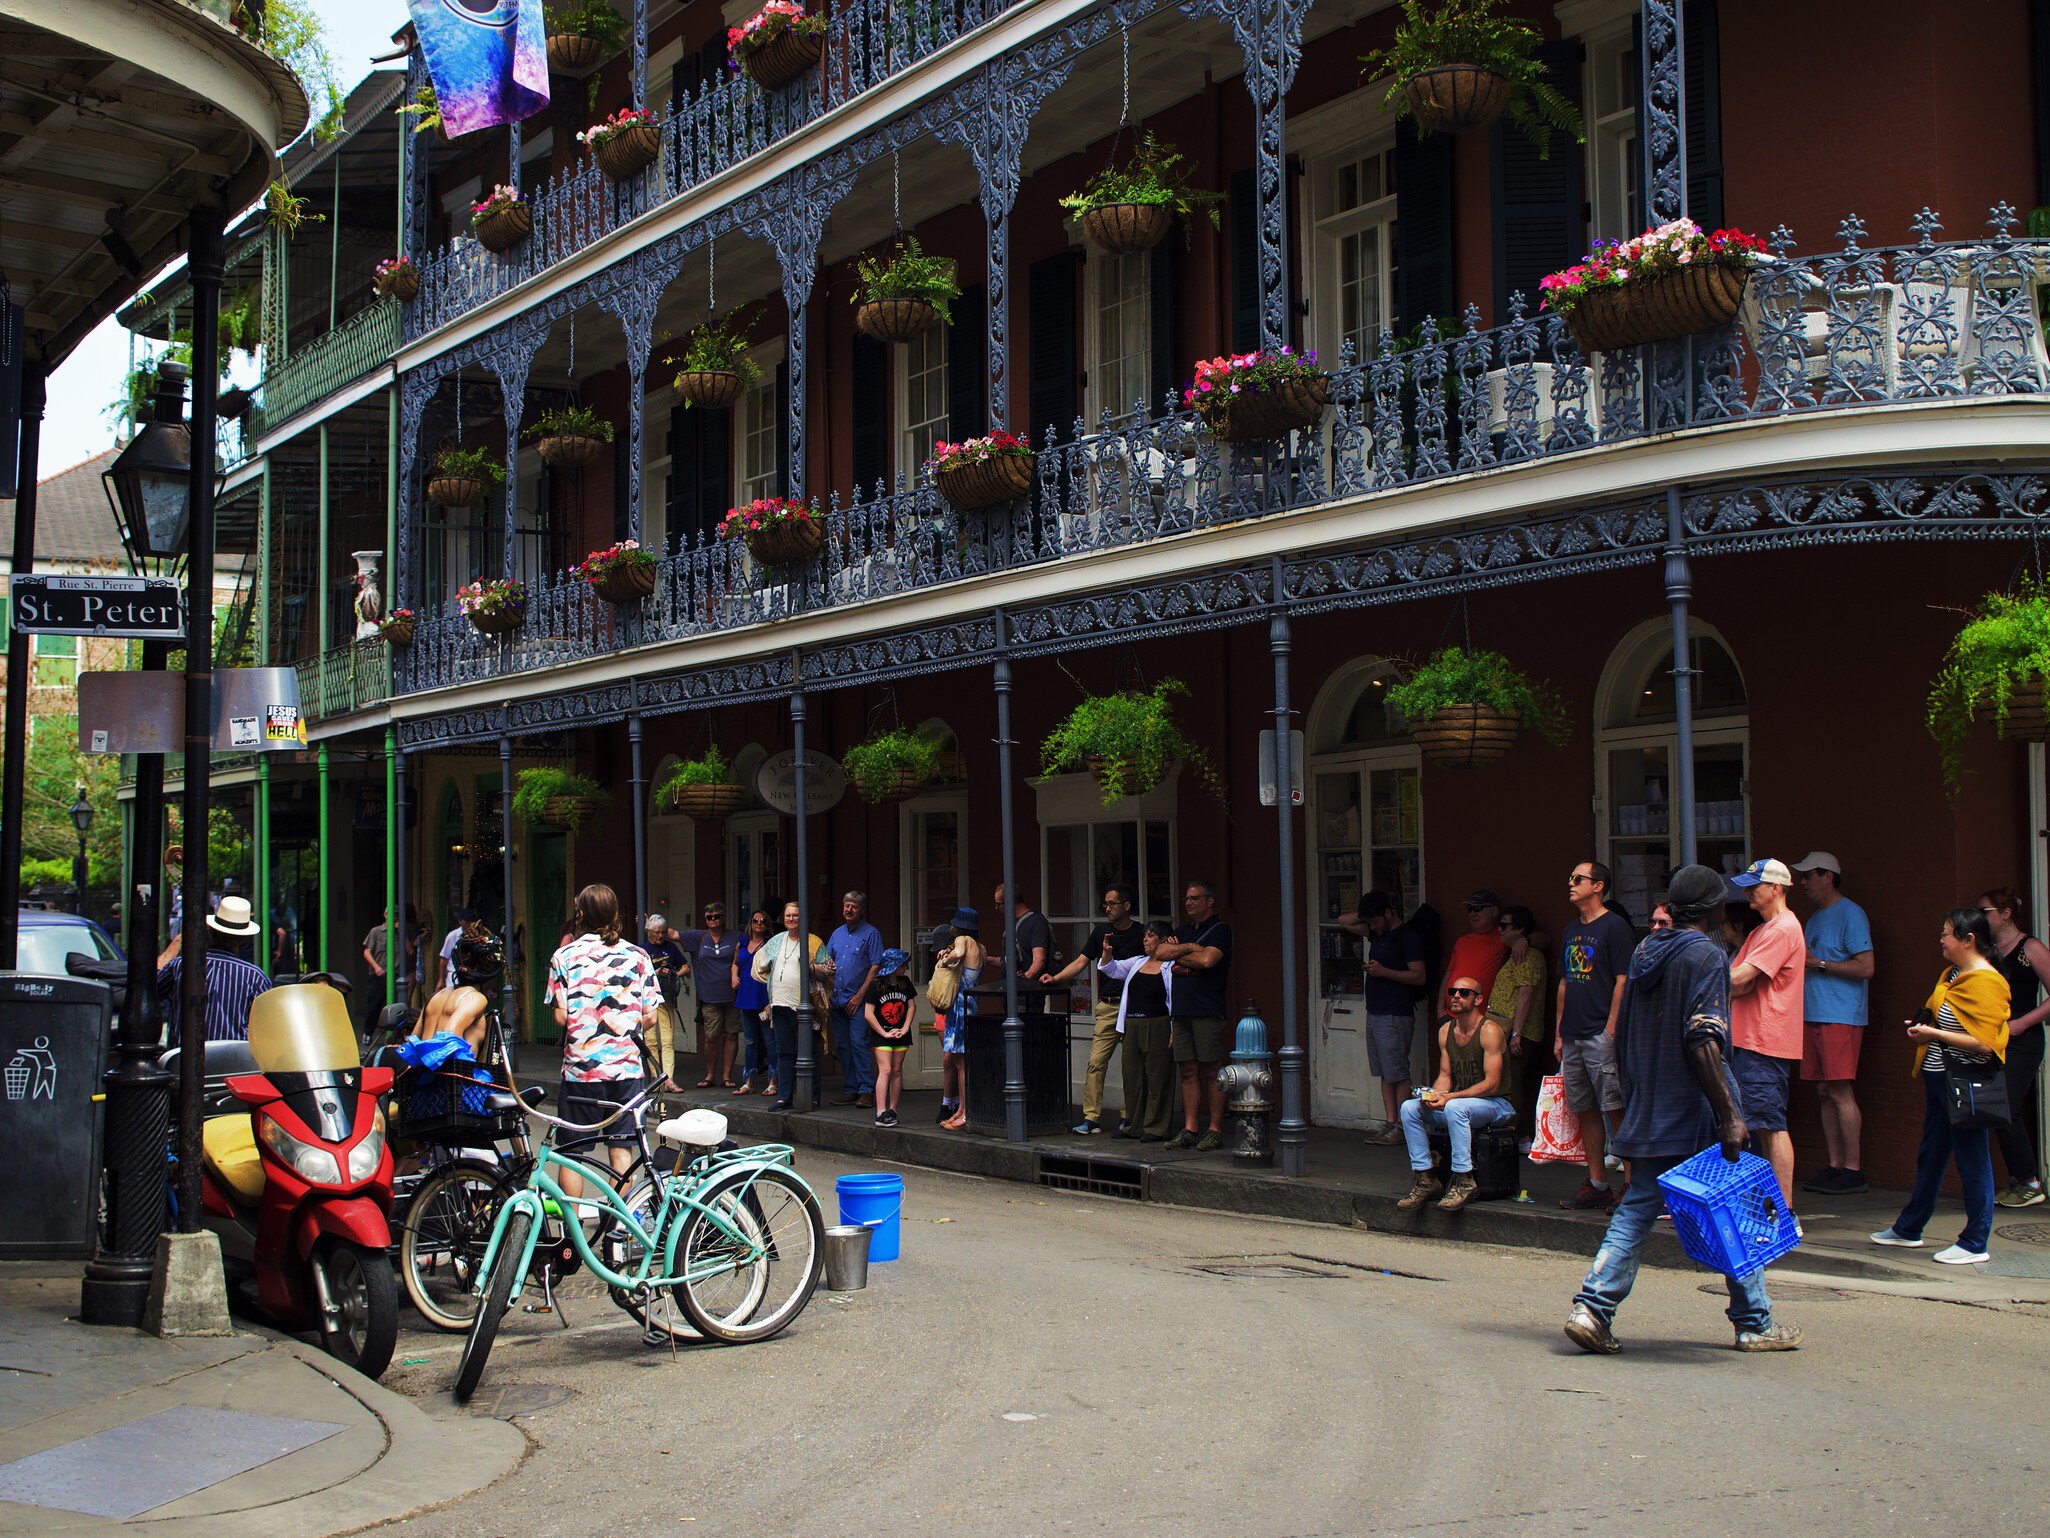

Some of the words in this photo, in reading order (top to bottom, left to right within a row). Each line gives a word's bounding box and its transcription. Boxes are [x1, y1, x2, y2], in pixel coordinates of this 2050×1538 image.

[59, 579, 80, 589] Rue
[84, 580, 98, 590] St.
[102, 581, 135, 590] Pierre
[19, 594, 64, 622] St.
[81, 596, 173, 624] Peter
[268, 705, 297, 717] JESUS
[268, 726, 296, 739] HELL
[769, 756, 834, 777] FORVER
[770, 791, 790, 800] NEW
[794, 792, 834, 800] LEANS
[1551, 1140, 1578, 1151] PAACE
